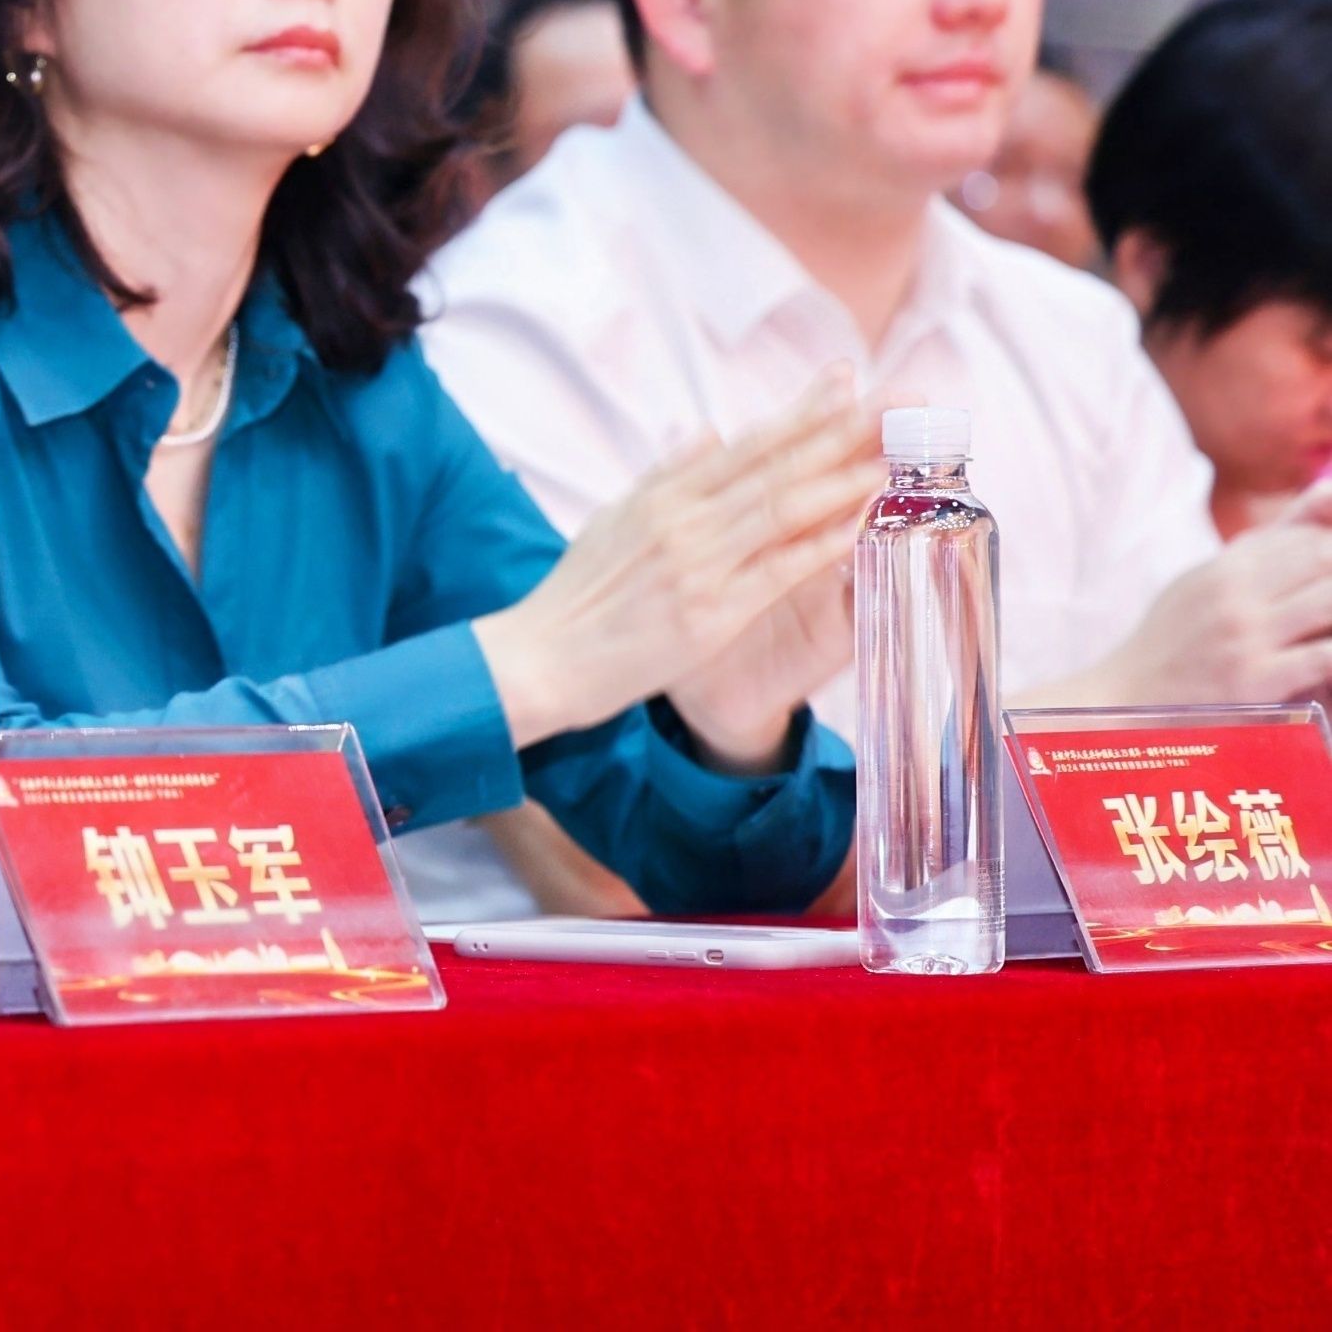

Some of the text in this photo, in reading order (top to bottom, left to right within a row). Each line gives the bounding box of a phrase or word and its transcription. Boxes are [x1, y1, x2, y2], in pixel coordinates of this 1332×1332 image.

[82, 824, 323, 931] 钟玉军
[1102, 789, 1313, 885] 张绘薇
